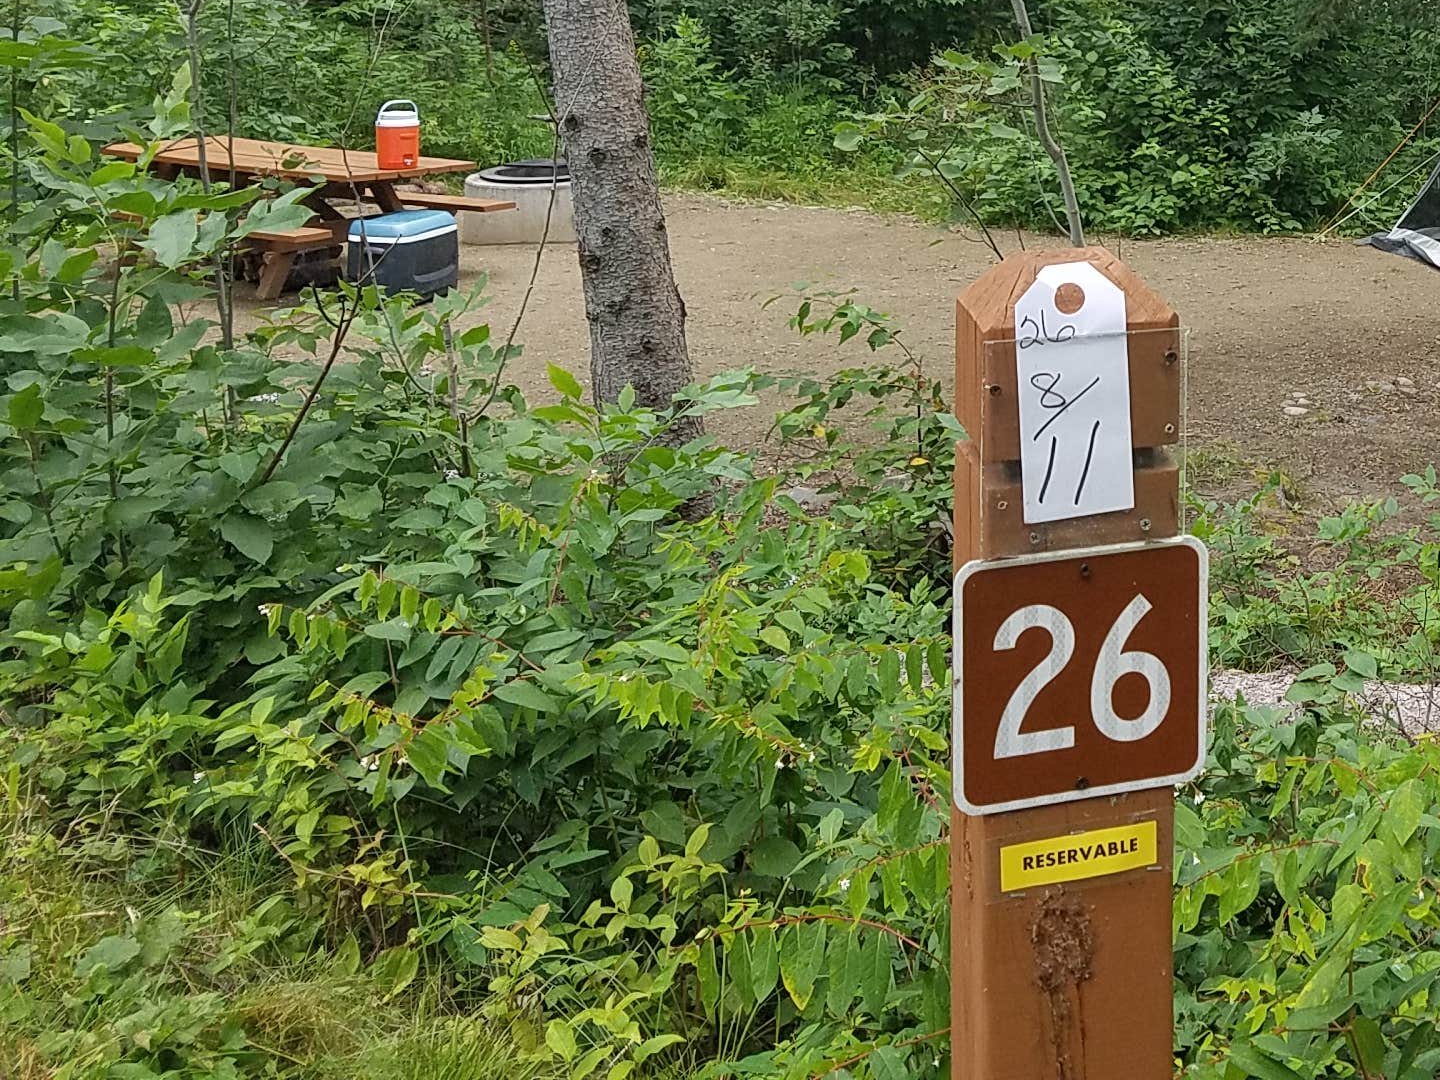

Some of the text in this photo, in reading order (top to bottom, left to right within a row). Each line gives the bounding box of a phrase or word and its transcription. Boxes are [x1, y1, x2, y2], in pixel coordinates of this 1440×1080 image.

[1019, 310, 1075, 349] 26
[993, 593, 1171, 759] 26
[1022, 837, 1139, 871] RESERVABLE
